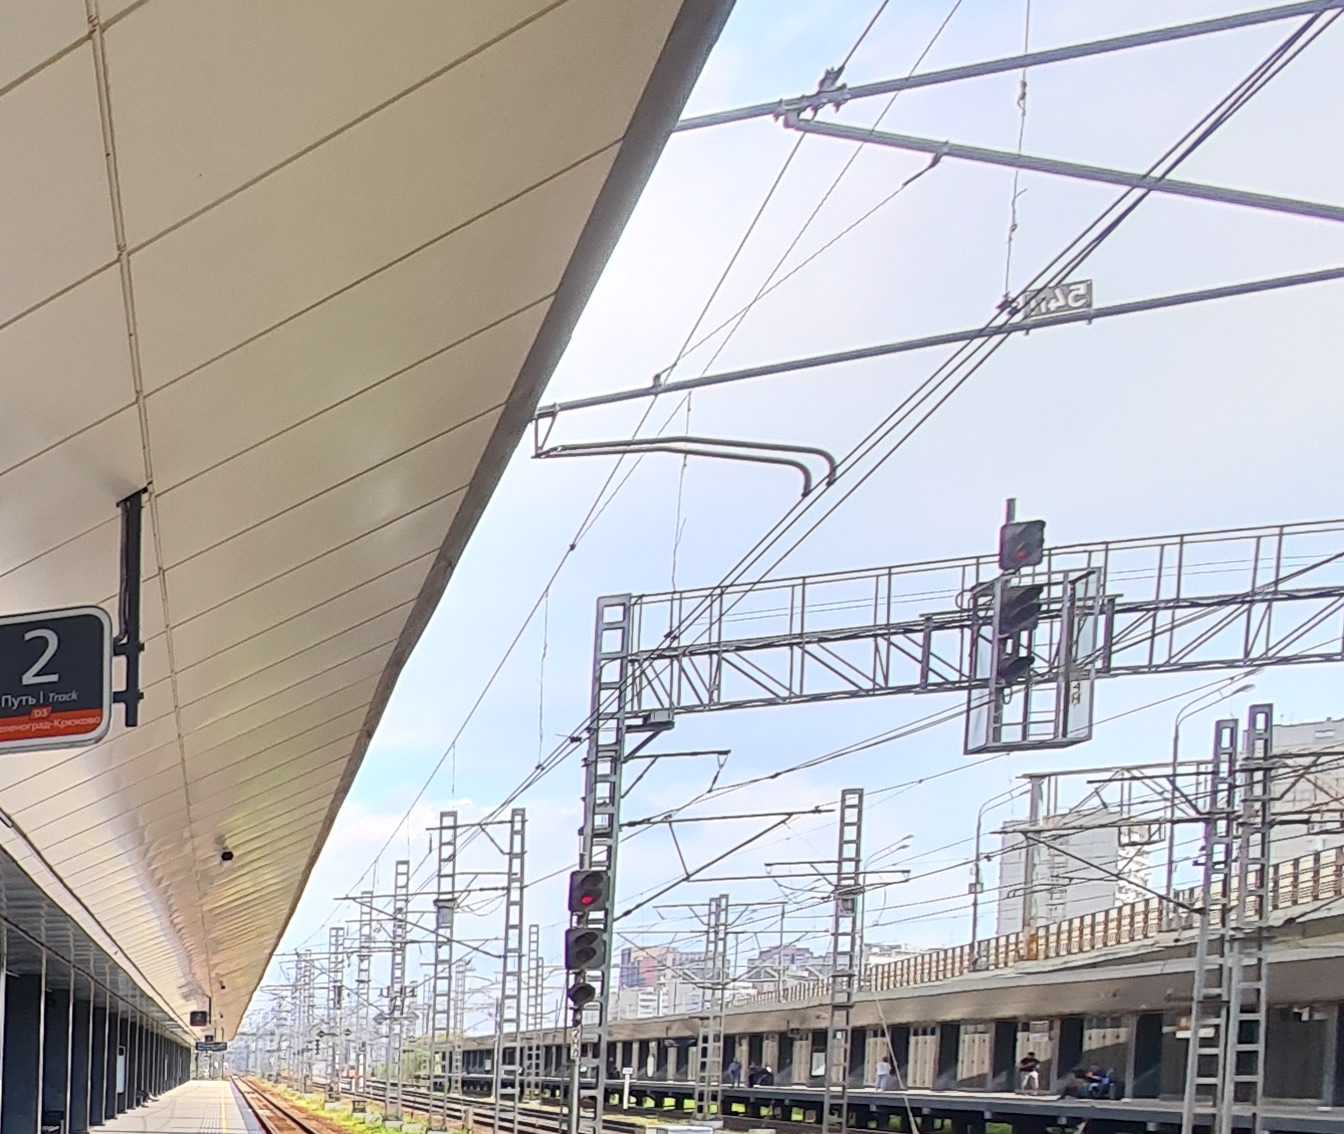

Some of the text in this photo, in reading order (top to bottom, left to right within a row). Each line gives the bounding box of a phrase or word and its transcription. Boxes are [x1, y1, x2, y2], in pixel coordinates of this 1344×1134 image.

[22, 629, 59, 685] 2
[0, 694, 37, 710] Путь
[48, 690, 79, 703] Track
